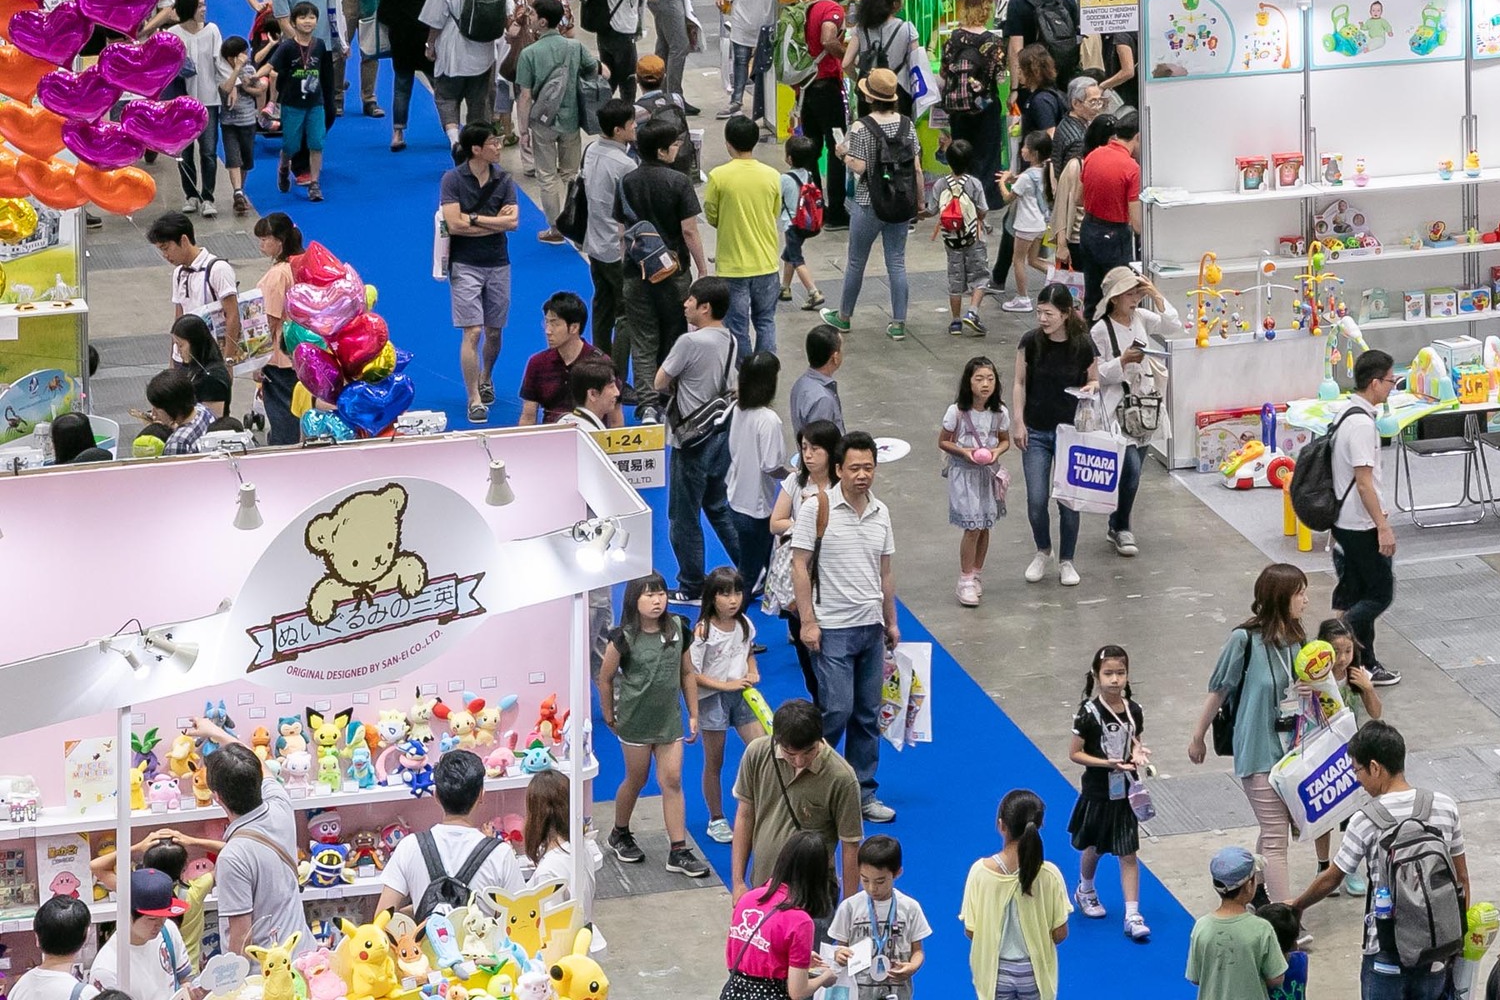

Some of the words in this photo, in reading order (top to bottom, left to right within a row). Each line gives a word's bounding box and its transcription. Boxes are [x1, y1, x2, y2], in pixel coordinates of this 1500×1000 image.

[606, 433, 643, 448] 1-24
[614, 458, 656, 473] 貿易㈱
[1073, 452, 1115, 471] TAKARA
[1073, 465, 1114, 486] TOMY
[277, 585, 454, 649] ぬいぐるみの三英
[286, 665, 325, 680] ORIGINAL
[326, 666, 368, 680] DESIGNED
[369, 662, 380, 674] BY
[382, 650, 409, 669] SAN-EI
